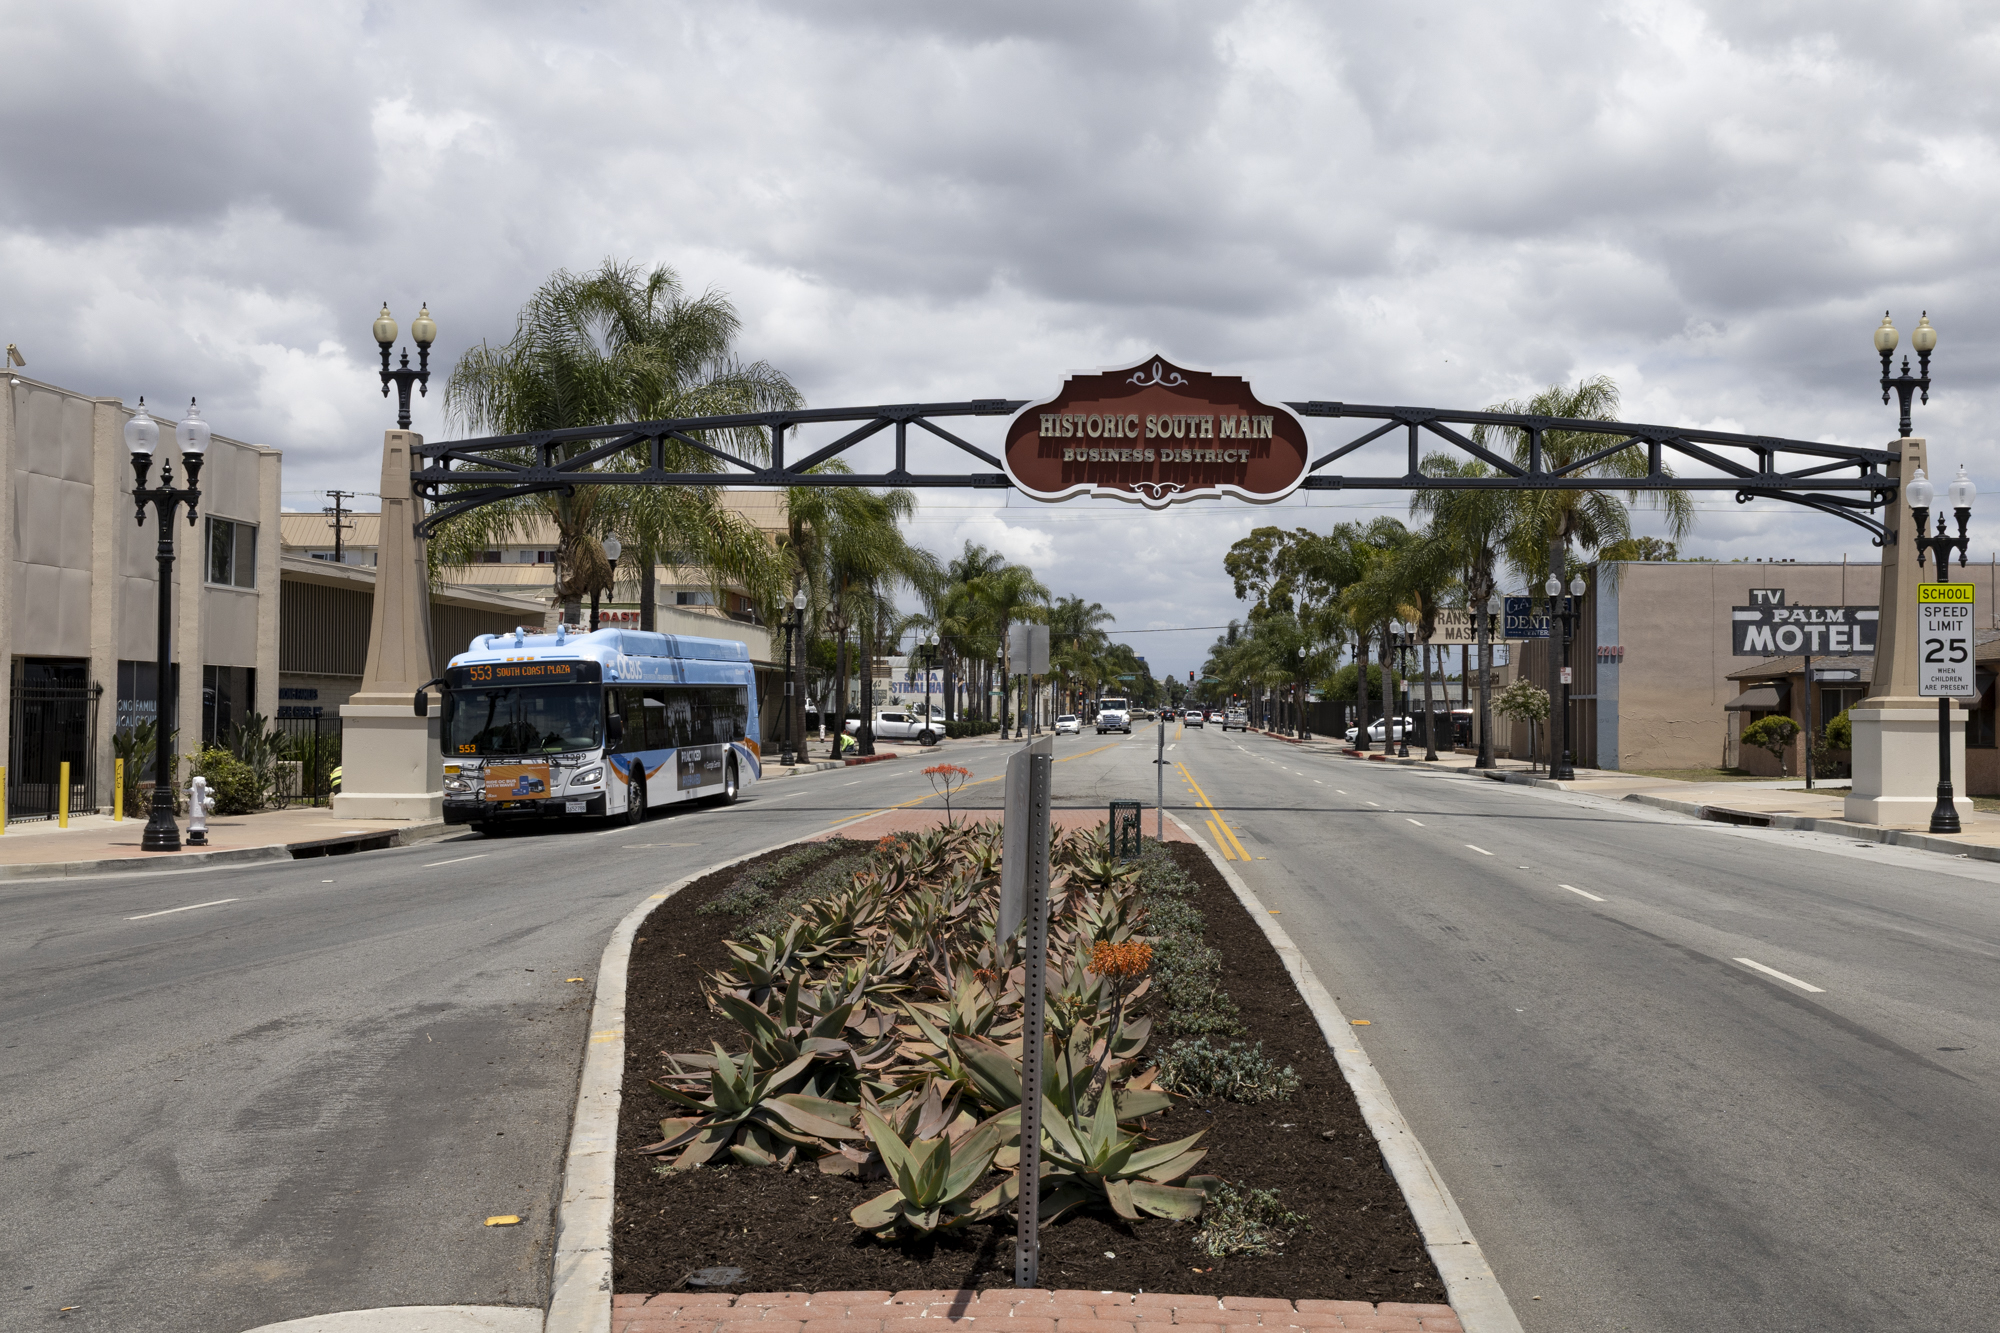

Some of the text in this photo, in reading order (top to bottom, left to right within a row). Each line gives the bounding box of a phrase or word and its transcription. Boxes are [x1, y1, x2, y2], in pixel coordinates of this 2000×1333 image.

[1039, 414, 1274, 439] HISTORIC SOUTH MAIN
[1063, 448, 1250, 463] BUSINESS DISTRICT
[1753, 590, 1782, 604] TV
[1922, 588, 1970, 600] SCHOOL
[590, 611, 640, 622] OAST
[1772, 609, 1845, 622] PALM
[1924, 606, 1968, 617] SPEED
[1506, 615, 1550, 629] DENT
[1928, 620, 1962, 631] LIMIT
[1743, 625, 1874, 651] MOTEL
[1597, 645, 1624, 656] 2209
[1924, 638, 1968, 663] 25
[470, 664, 571, 681] 553 SOUTH COAST PLAZA
[459, 744, 476, 753] 553
